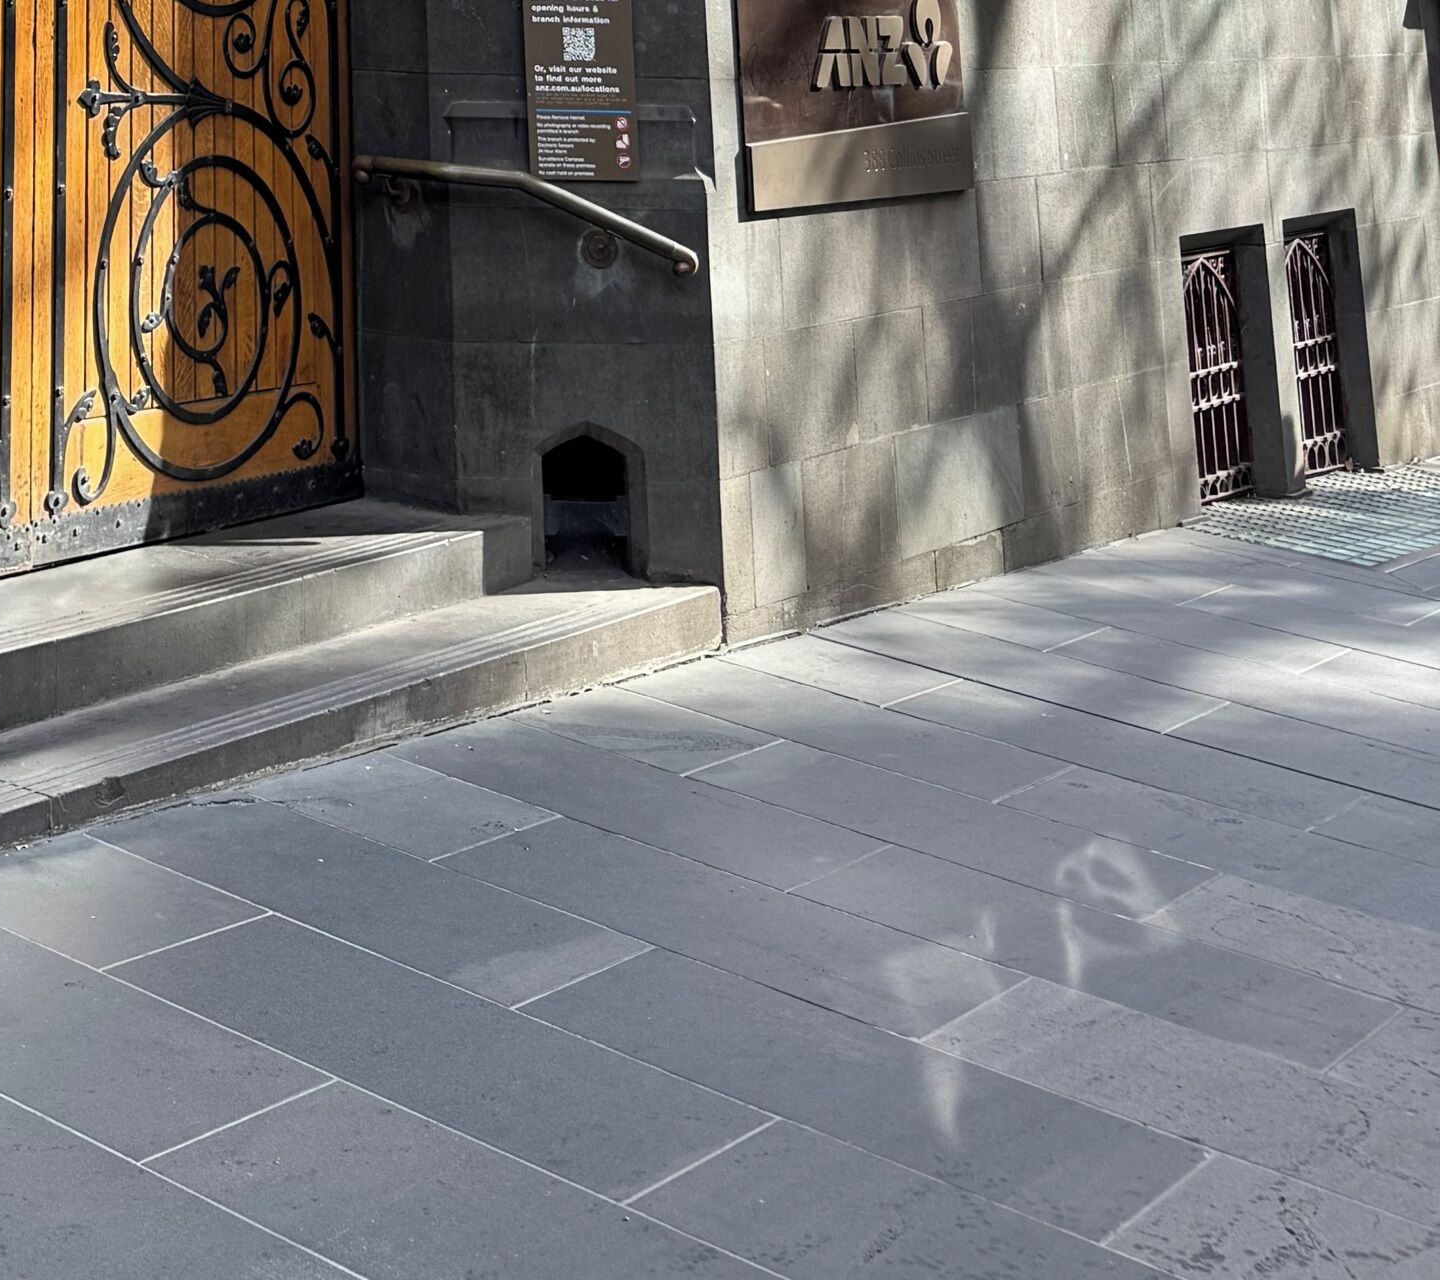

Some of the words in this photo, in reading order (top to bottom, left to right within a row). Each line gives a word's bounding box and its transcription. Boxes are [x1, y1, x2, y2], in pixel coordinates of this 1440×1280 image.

[531, 4, 564, 13] opening
[563, 16, 610, 24] information
[811, 15, 907, 92] ANZ
[534, 65, 546, 73] Or,
[549, 65, 566, 73] visit
[585, 66, 617, 74] website
[535, 85, 620, 93] anz.com.au/locations
[888, 145, 926, 170] Collins
[927, 144, 960, 165] Street
